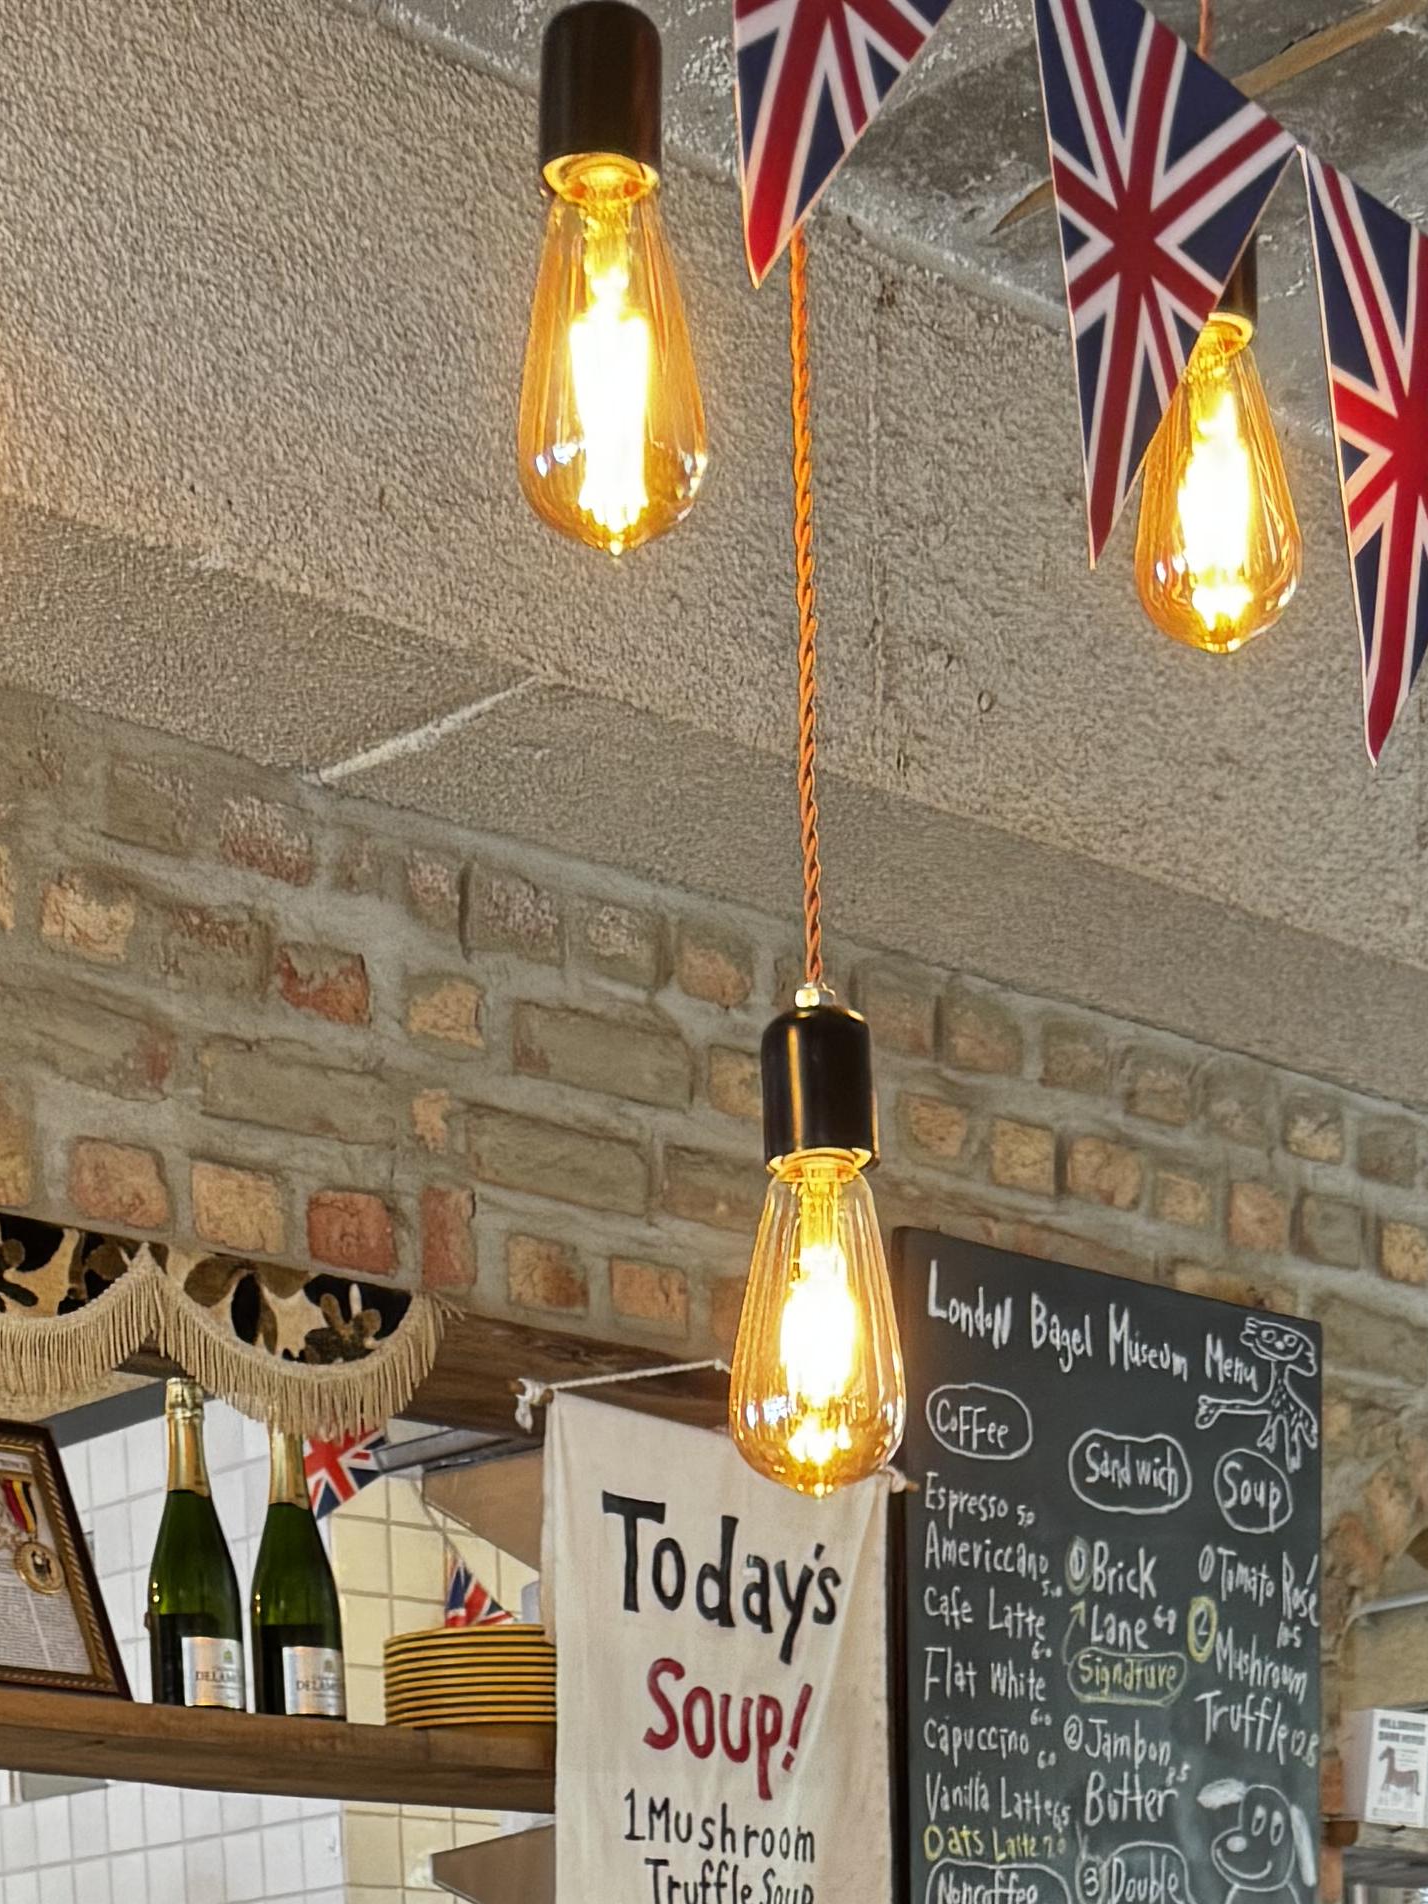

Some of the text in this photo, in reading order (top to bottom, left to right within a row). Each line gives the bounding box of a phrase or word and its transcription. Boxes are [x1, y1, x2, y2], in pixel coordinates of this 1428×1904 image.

[1031, 1294, 1092, 1372] Bagel
[1109, 1303, 1187, 1382] Museum
[1205, 1334, 1259, 1391] Menu
[925, 1472, 1008, 1530] Espresso
[1222, 1461, 1281, 1530] Soup
[600, 1490, 842, 1666] Today's
[1093, 1540, 1156, 1600] Brick
[1217, 1547, 1274, 1607] Tomato
[924, 1586, 1045, 1640] Cafe Latte
[1091, 1604, 1149, 1651] Lane
[924, 1647, 1046, 1702] Flat White
[1078, 1655, 1176, 1695] Signature
[642, 1656, 813, 1801] Soup!
[924, 1716, 1029, 1768] Capuccino
[1085, 1718, 1171, 1769] Jambon
[1194, 1690, 1289, 1765] Truffle
[926, 1771, 989, 1821] Vanilla
[1001, 1777, 1052, 1824] Latte
[1085, 1771, 1179, 1826] Butter
[923, 1825, 984, 1862] Oats
